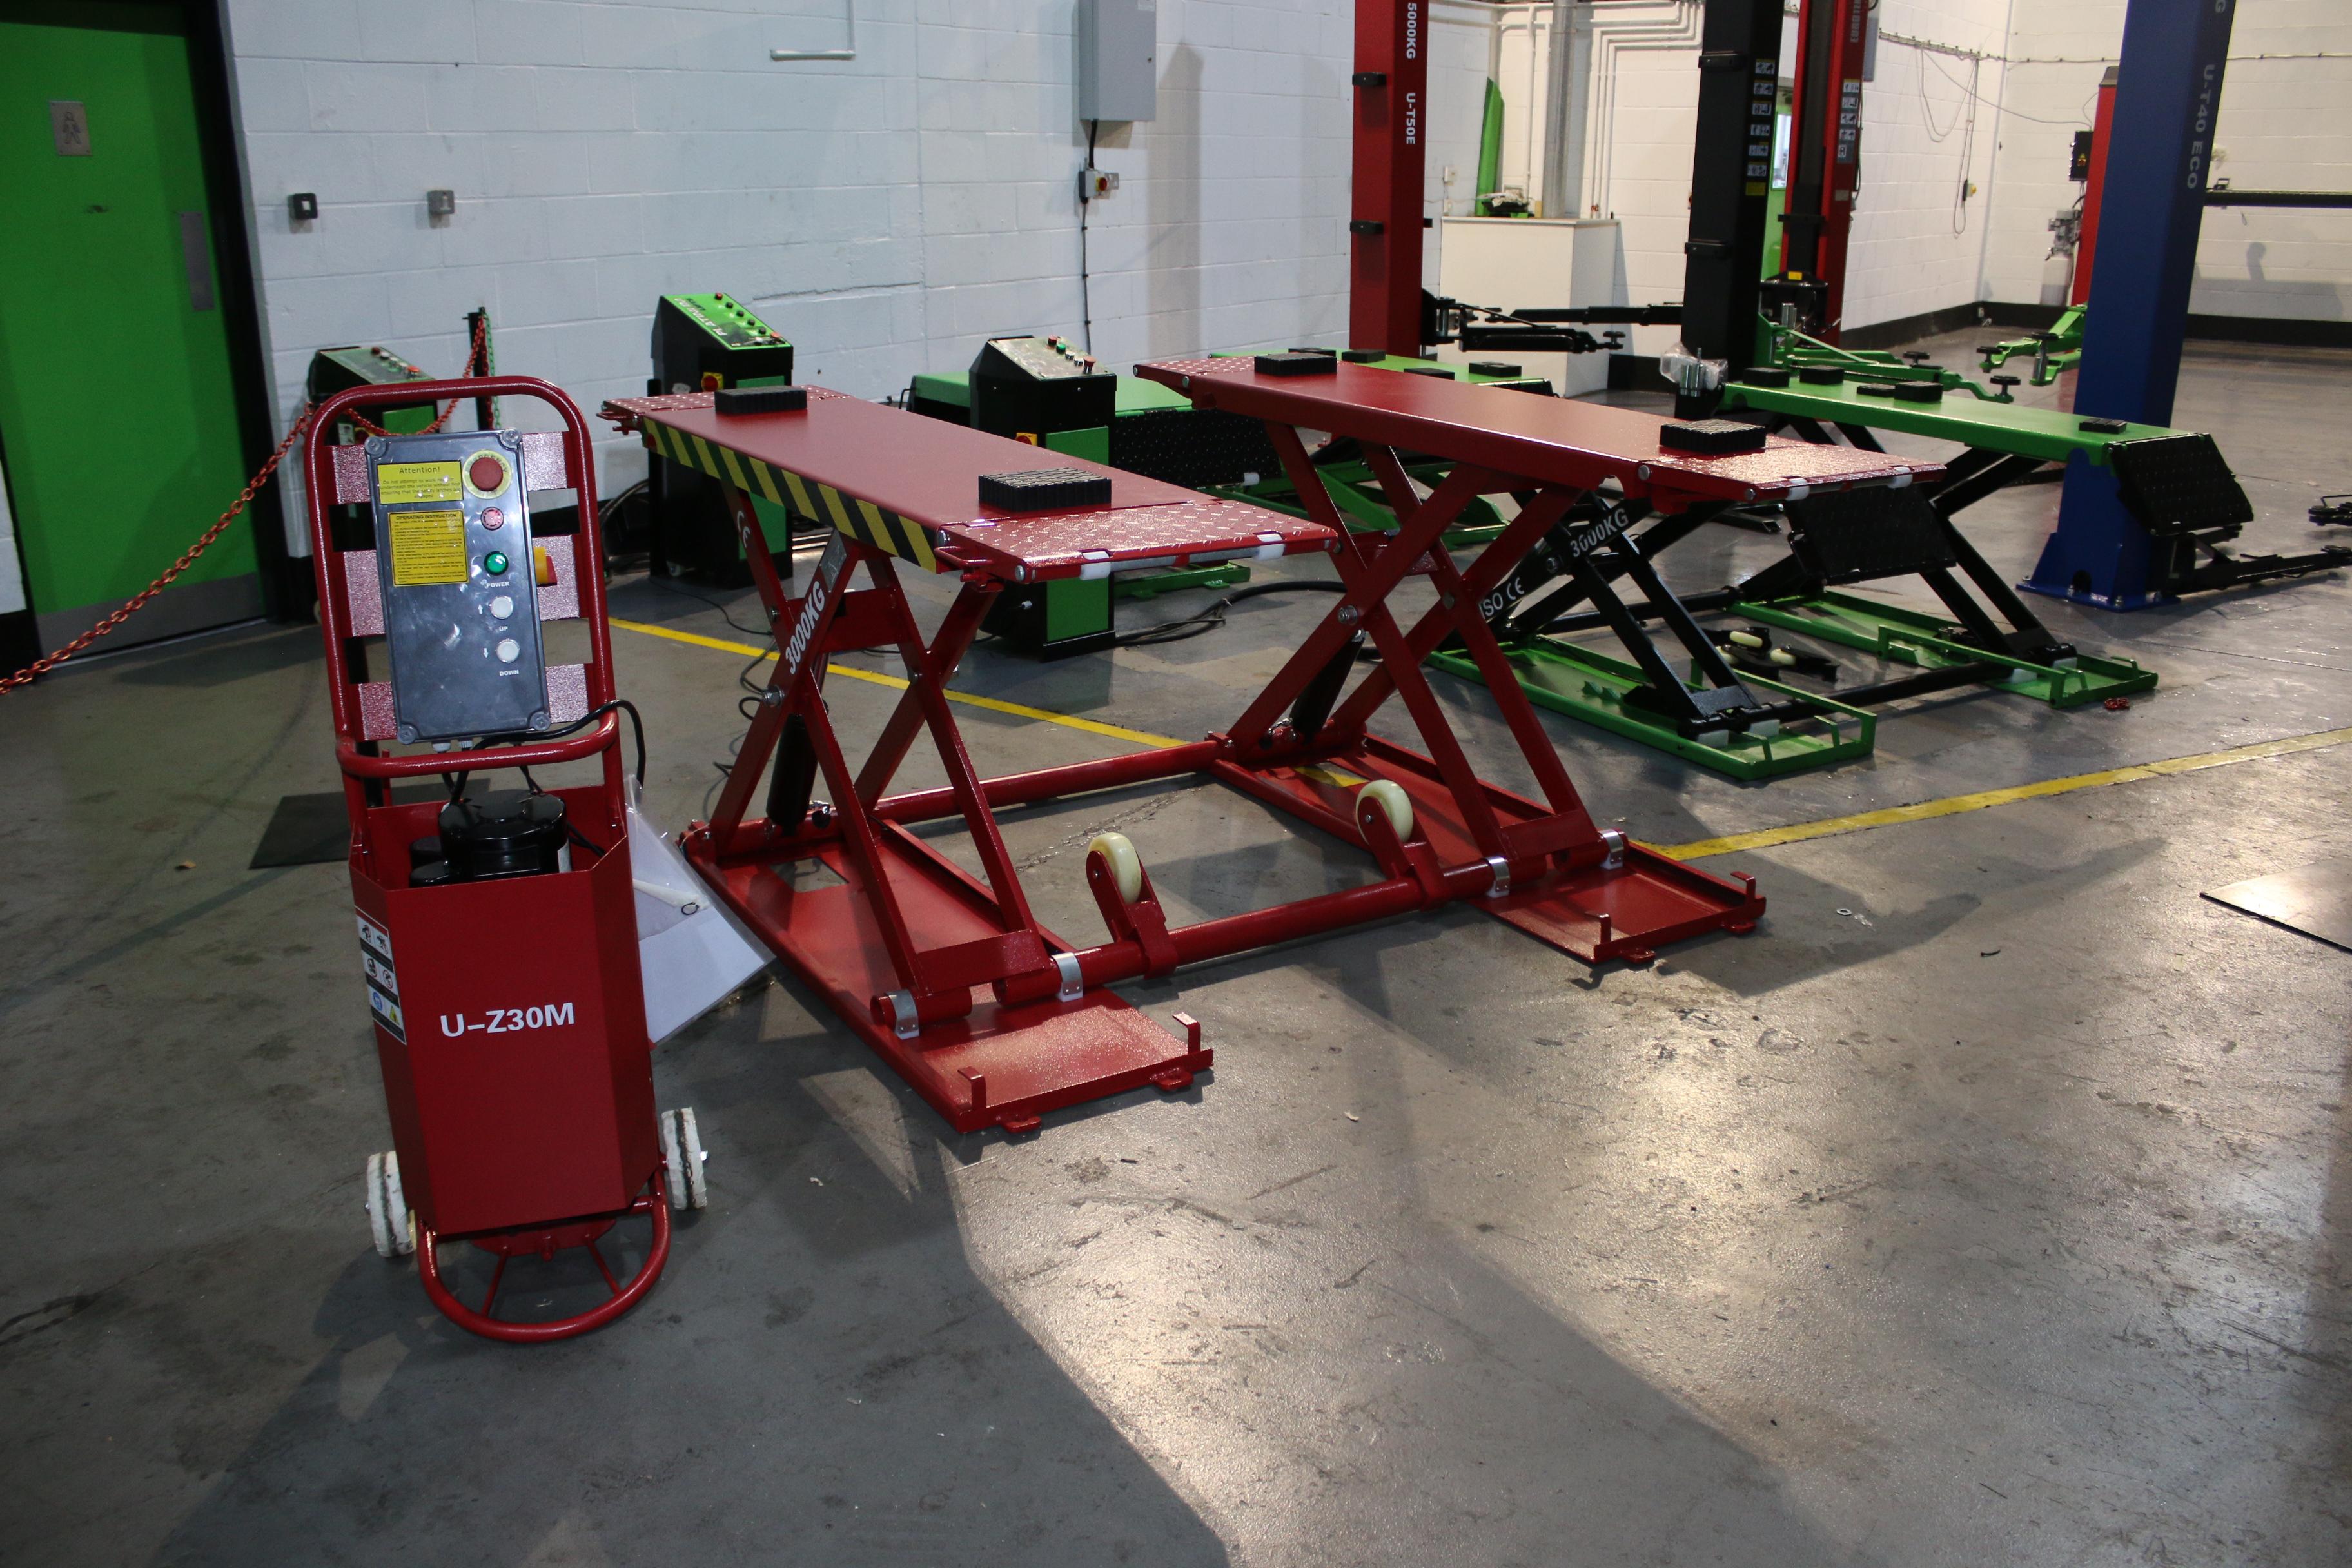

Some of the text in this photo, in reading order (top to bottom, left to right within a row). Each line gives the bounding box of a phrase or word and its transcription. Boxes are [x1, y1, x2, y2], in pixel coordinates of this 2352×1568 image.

[1406, 2, 1417, 59] 5000KG
[1406, 93, 1416, 145] U-T50E
[2186, 64, 2215, 189] U-T40 ECO
[1570, 508, 1629, 558] 3000KG
[785, 581, 825, 674] 3000KG
[1478, 592, 1503, 620] ISO
[440, 1003, 575, 1037] U-Z30M
